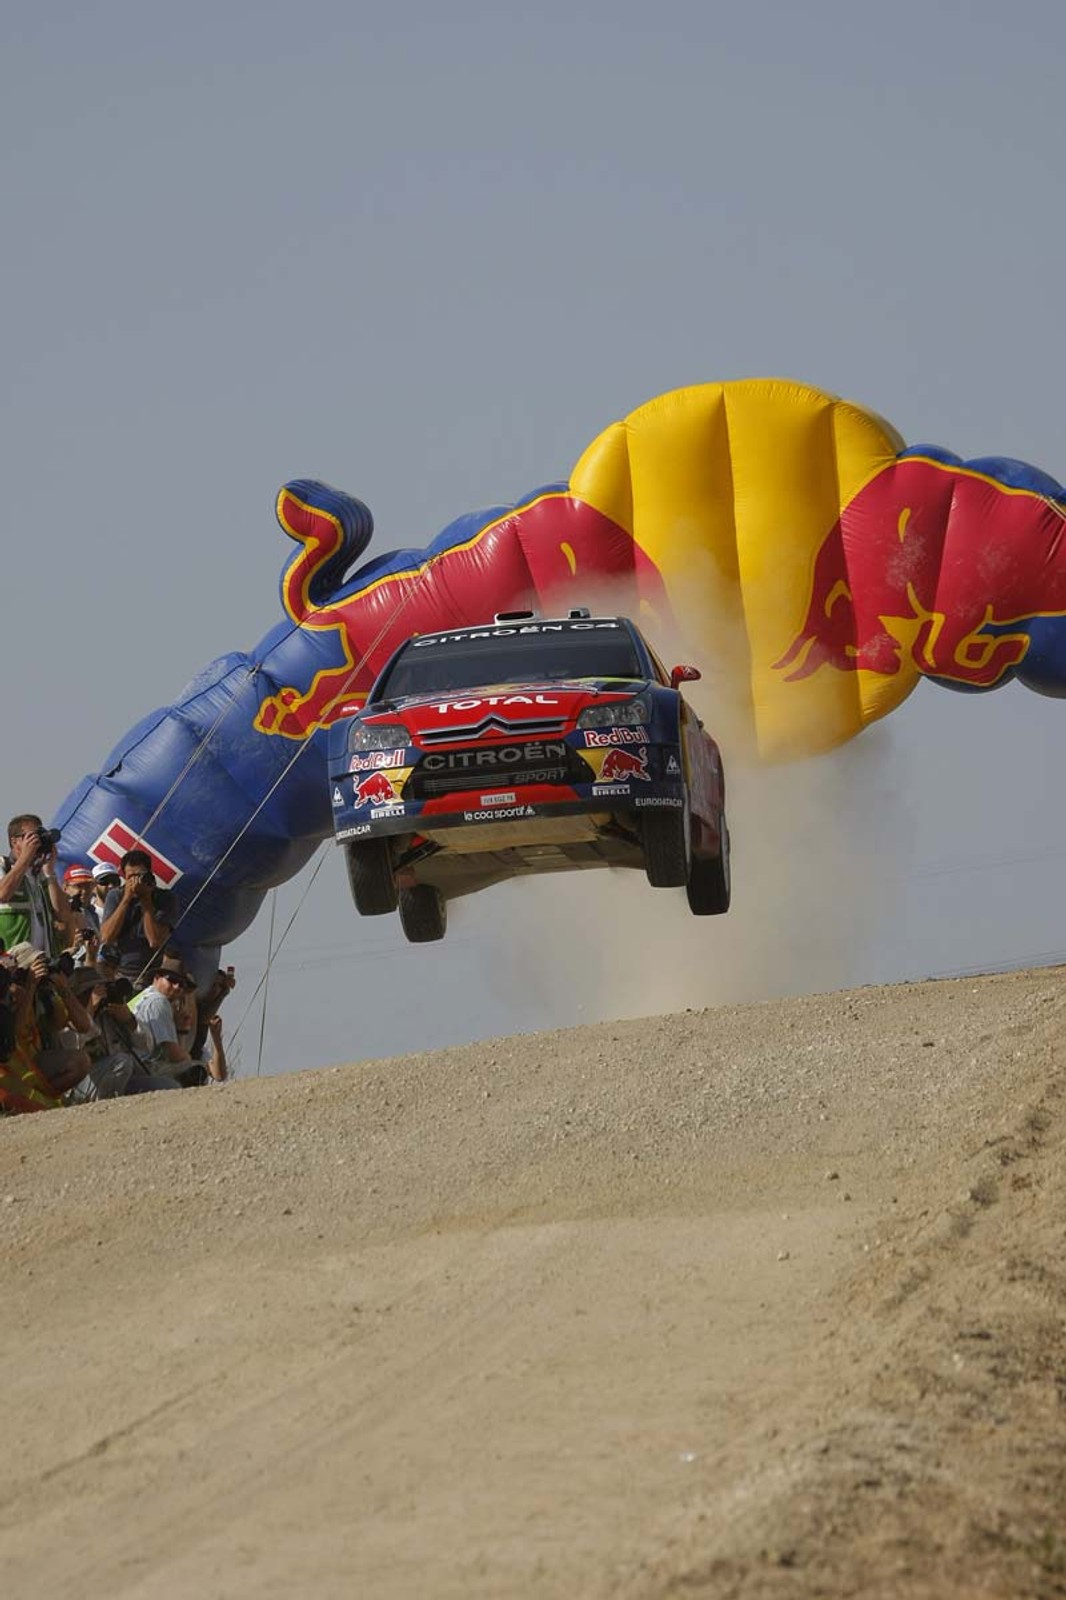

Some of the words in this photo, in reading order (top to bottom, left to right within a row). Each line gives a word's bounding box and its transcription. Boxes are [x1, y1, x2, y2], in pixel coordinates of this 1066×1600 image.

[413, 624, 563, 647] CITROËN
[570, 622, 620, 631] C4
[430, 694, 559, 713] TOTAL
[584, 727, 621, 747] Red
[423, 741, 567, 770] CITROËN
[513, 767, 569, 784] SPORT
[592, 784, 631, 796] PIRELLI
[463, 810, 473, 821] le
[474, 810, 494, 820] coq
[494, 806, 525, 819] sportif
